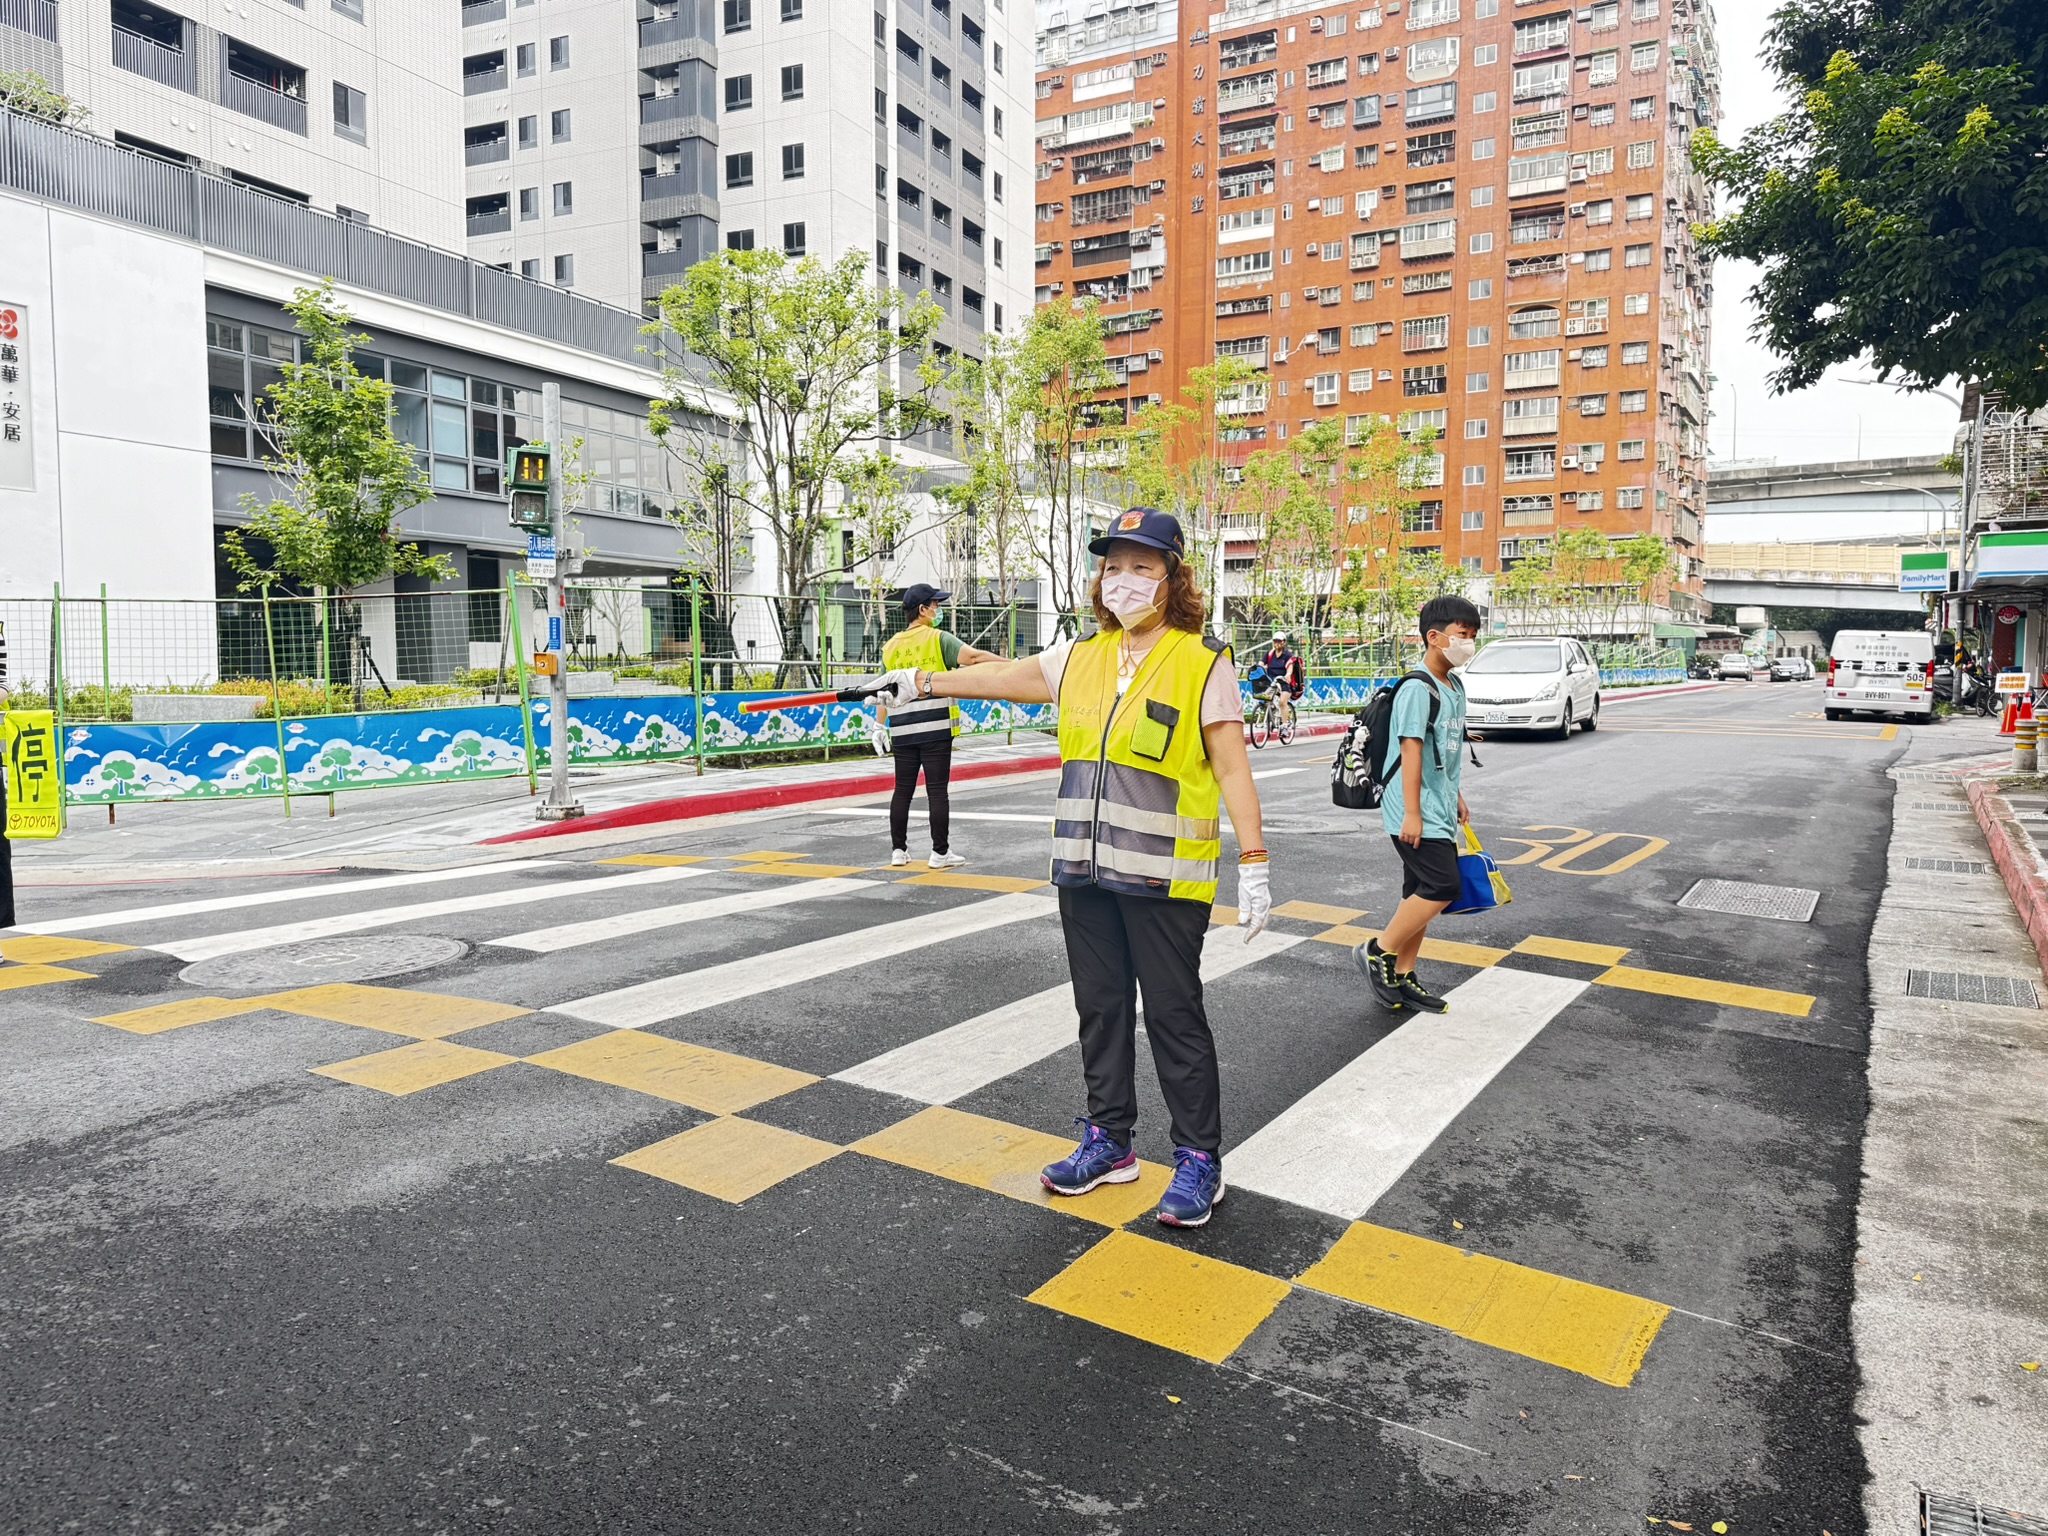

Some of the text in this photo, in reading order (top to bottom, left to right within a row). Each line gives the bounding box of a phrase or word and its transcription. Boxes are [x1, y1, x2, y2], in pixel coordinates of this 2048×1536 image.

[1191, 63, 1206, 213] 力霸大別墅
[523, 457, 544, 481] 11
[1902, 574, 1946, 583] FamilyMart
[1906, 673, 1924, 682] 505
[12, 723, 48, 802] 停
[23, 815, 56, 828] TOYOTA
[1494, 824, 1670, 876] 30
